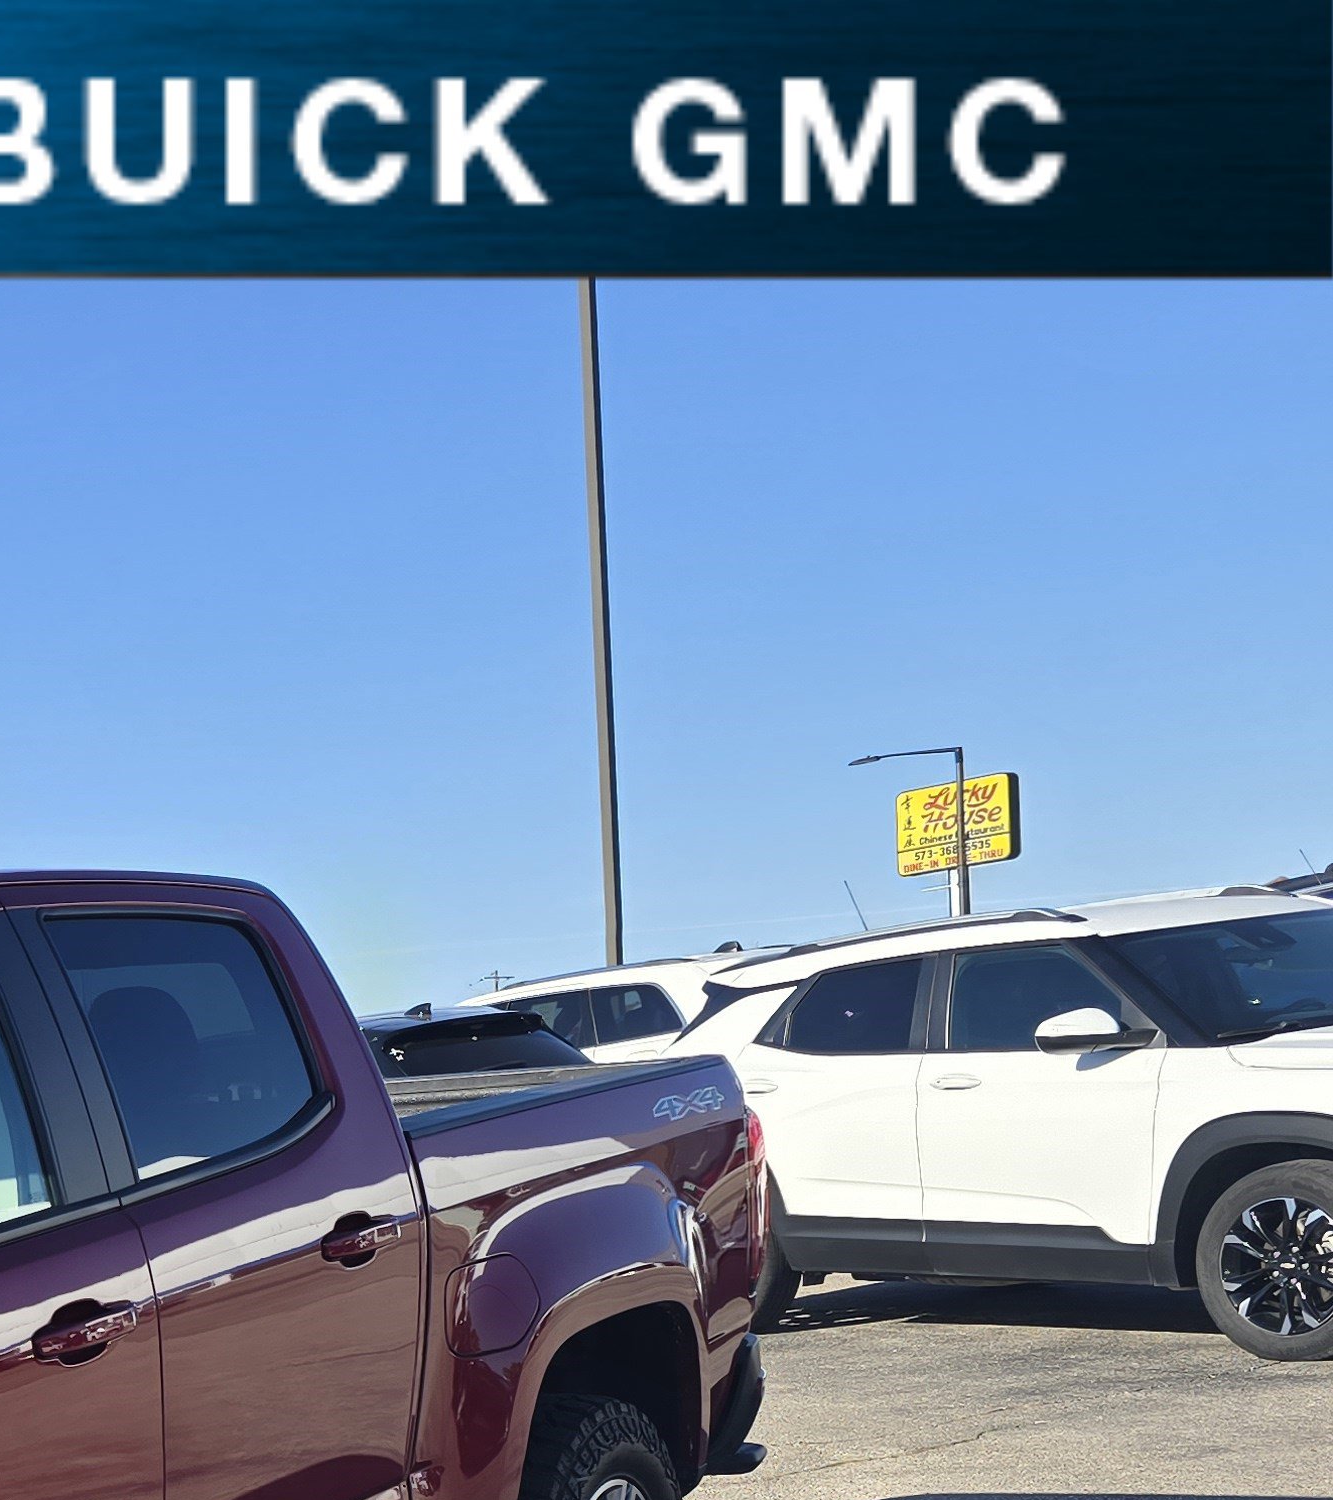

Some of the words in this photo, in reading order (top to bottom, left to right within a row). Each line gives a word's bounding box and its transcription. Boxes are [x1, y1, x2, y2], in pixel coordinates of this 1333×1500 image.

[923, 782, 998, 811] Luky
[921, 806, 1002, 833] House
[915, 839, 991, 860] 573-3685535
[919, 834, 953, 846] Chinese
[904, 859, 939, 873] DINE-IN
[945, 849, 1004, 866] DRE-THRU
